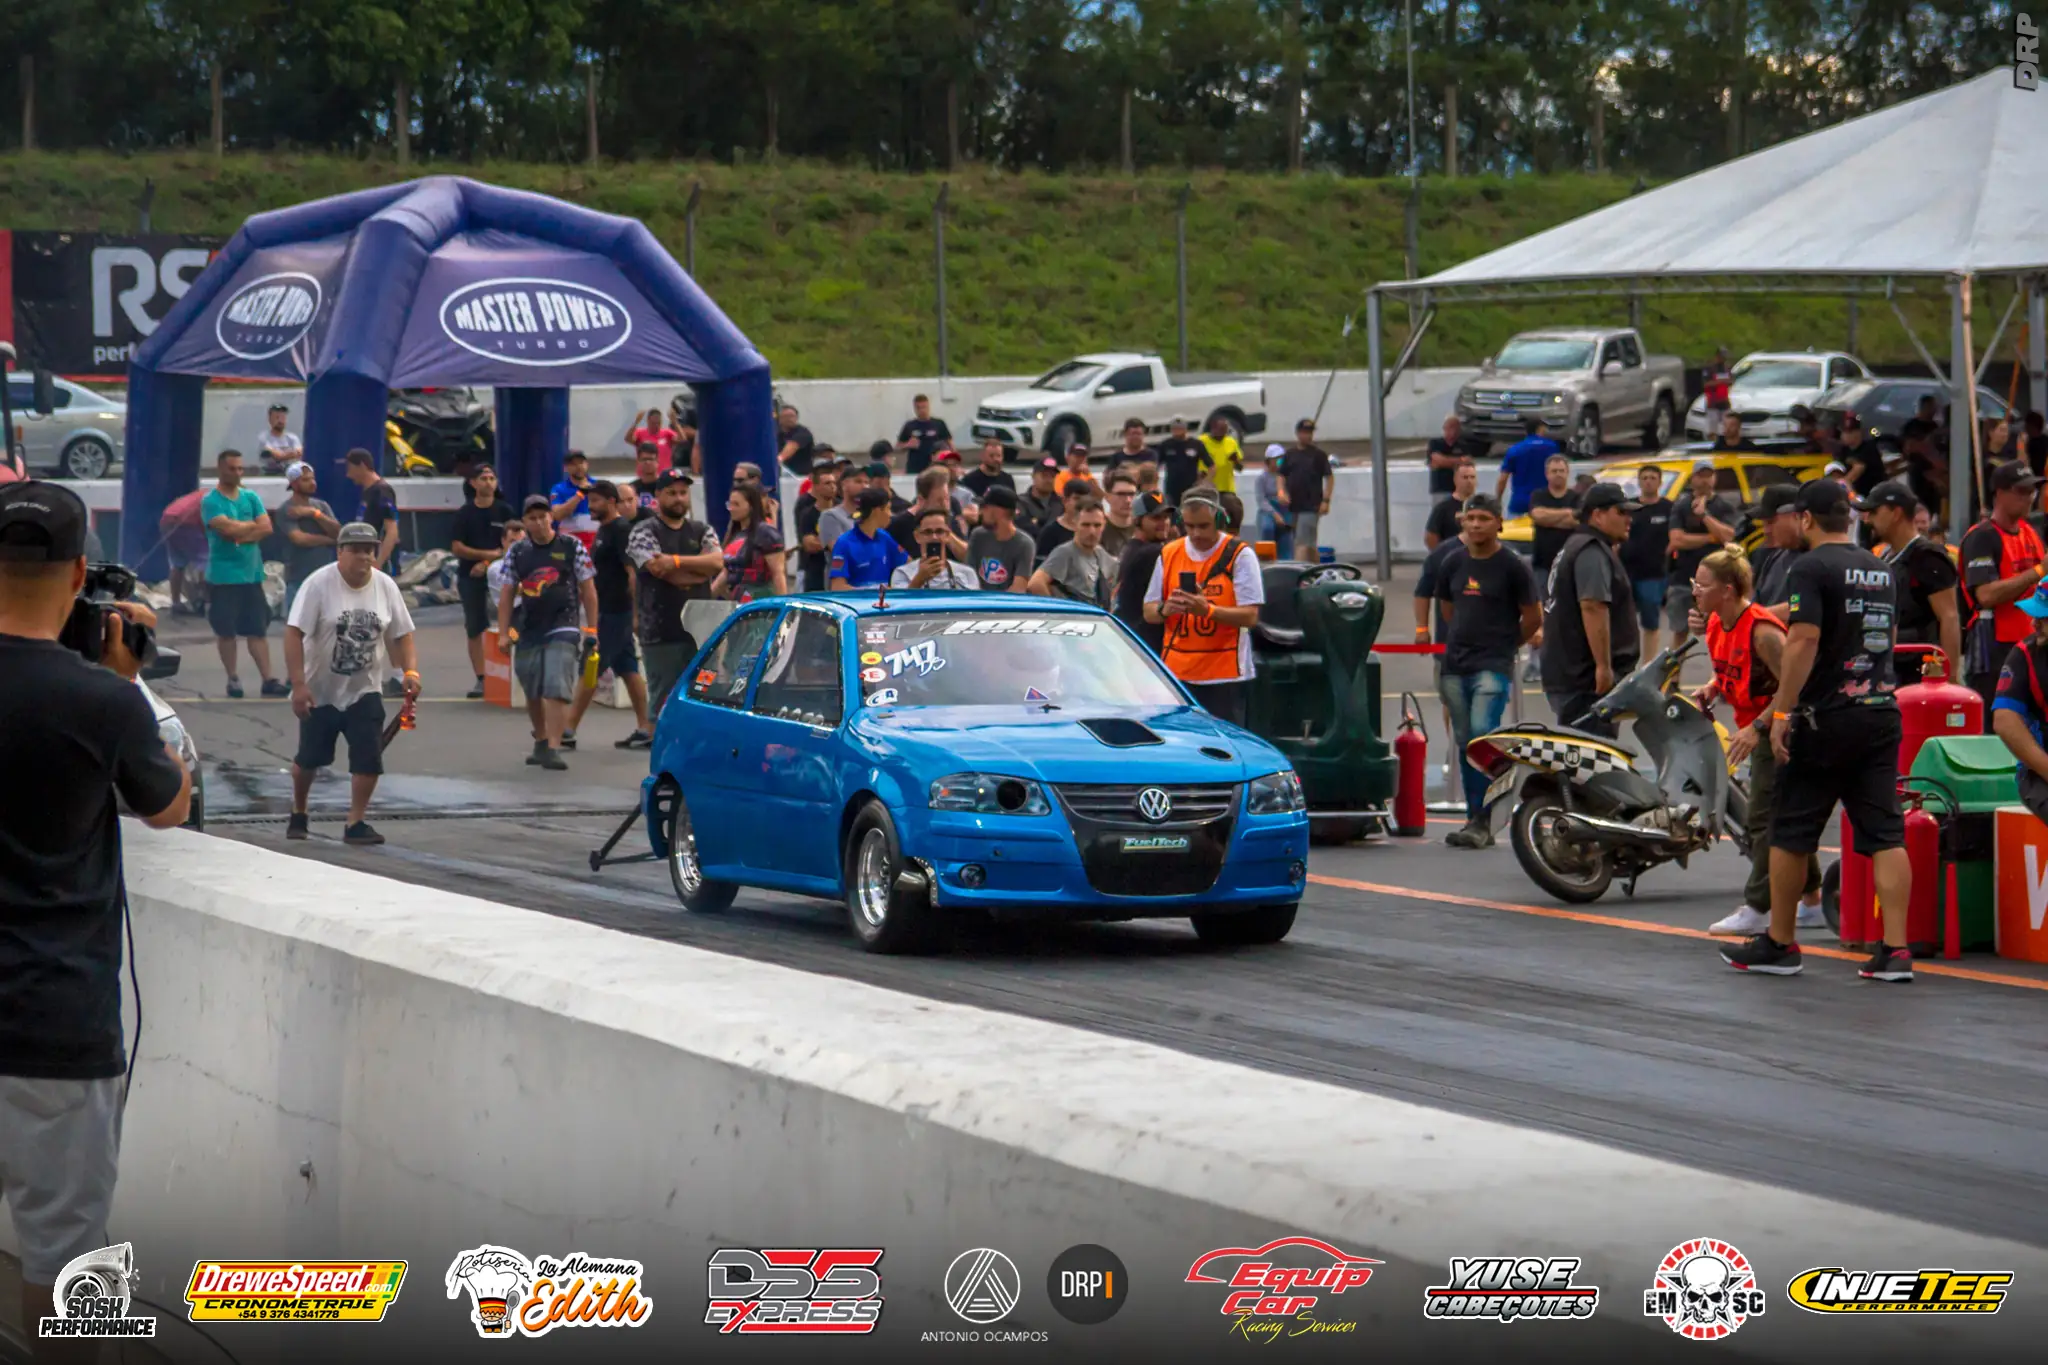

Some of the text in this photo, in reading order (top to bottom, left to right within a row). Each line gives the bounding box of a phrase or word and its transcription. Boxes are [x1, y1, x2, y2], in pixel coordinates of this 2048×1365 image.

[454, 291, 616, 333] MASTER POWER
[497, 339, 588, 349] TURBO
[884, 640, 937, 676] 747
